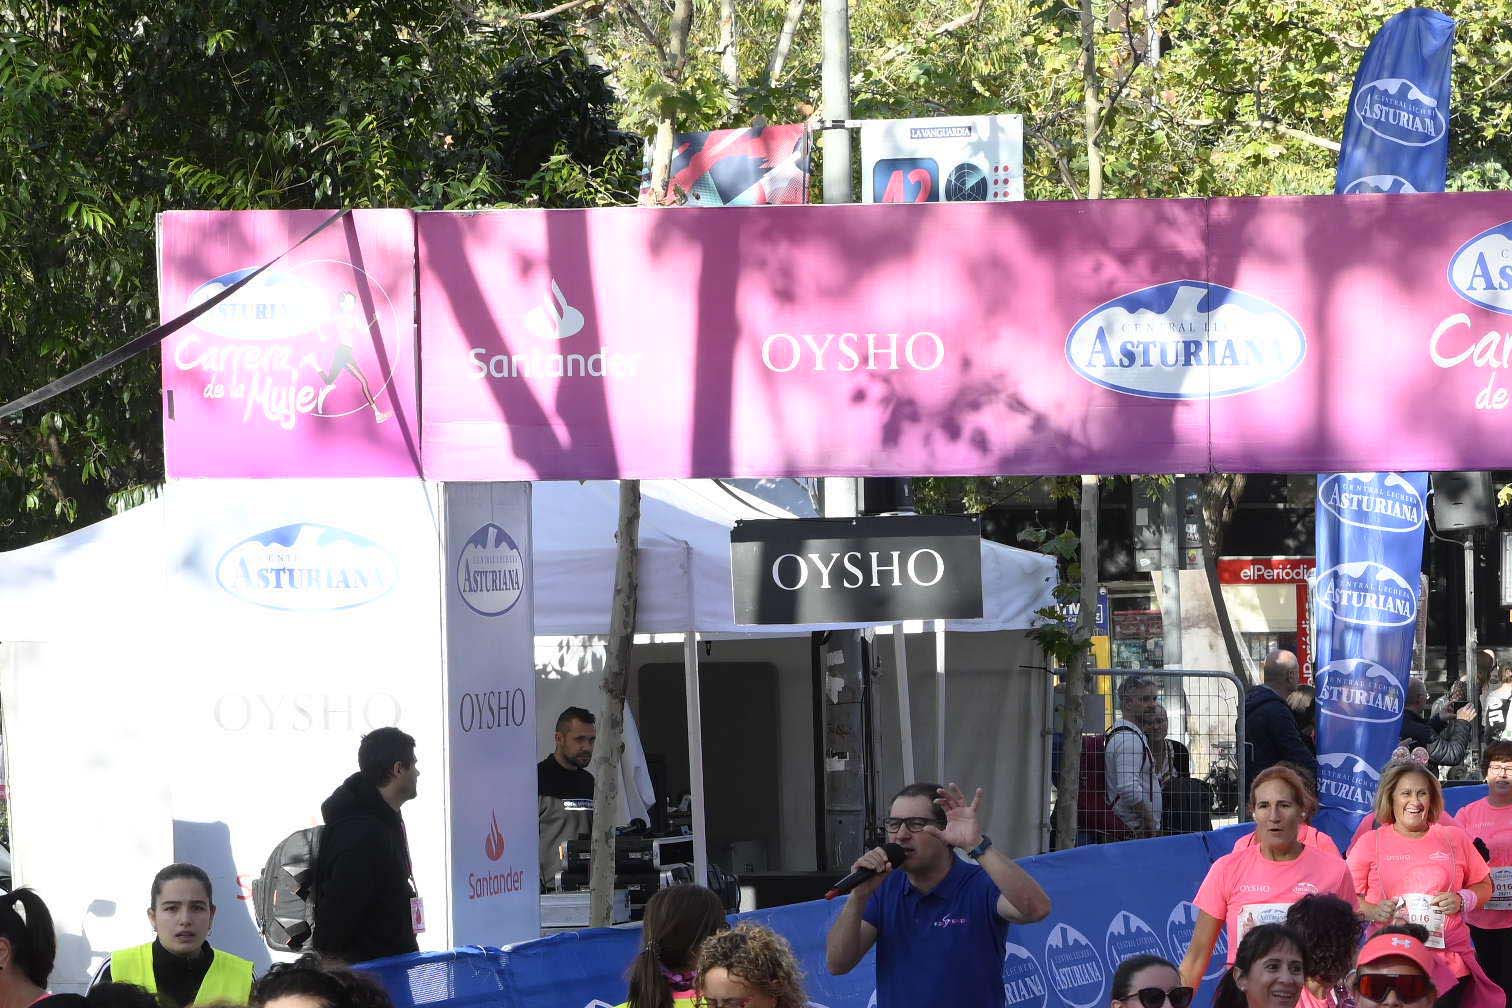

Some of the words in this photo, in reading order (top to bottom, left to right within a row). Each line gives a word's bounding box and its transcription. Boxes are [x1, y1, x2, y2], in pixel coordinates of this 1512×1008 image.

[911, 129, 920, 138] LA
[922, 127, 970, 139] VANGUARDIA
[468, 346, 641, 379] Santander
[762, 332, 945, 373] OYSHO
[1087, 325, 1287, 369] ASTURIANA
[1475, 373, 1512, 411] de
[1328, 483, 1418, 523] ASTURIANA
[463, 559, 521, 594] ASTURIANA
[772, 548, 946, 592] OYSHO
[1325, 579, 1411, 617] ASTURIANA
[460, 688, 526, 733] OYSHO
[1320, 676, 1400, 713] STURIANA
[468, 868, 525, 900] Santander
[1240, 884, 1270, 894] OYSHO
[1051, 959, 1103, 992] ASTURIANA
